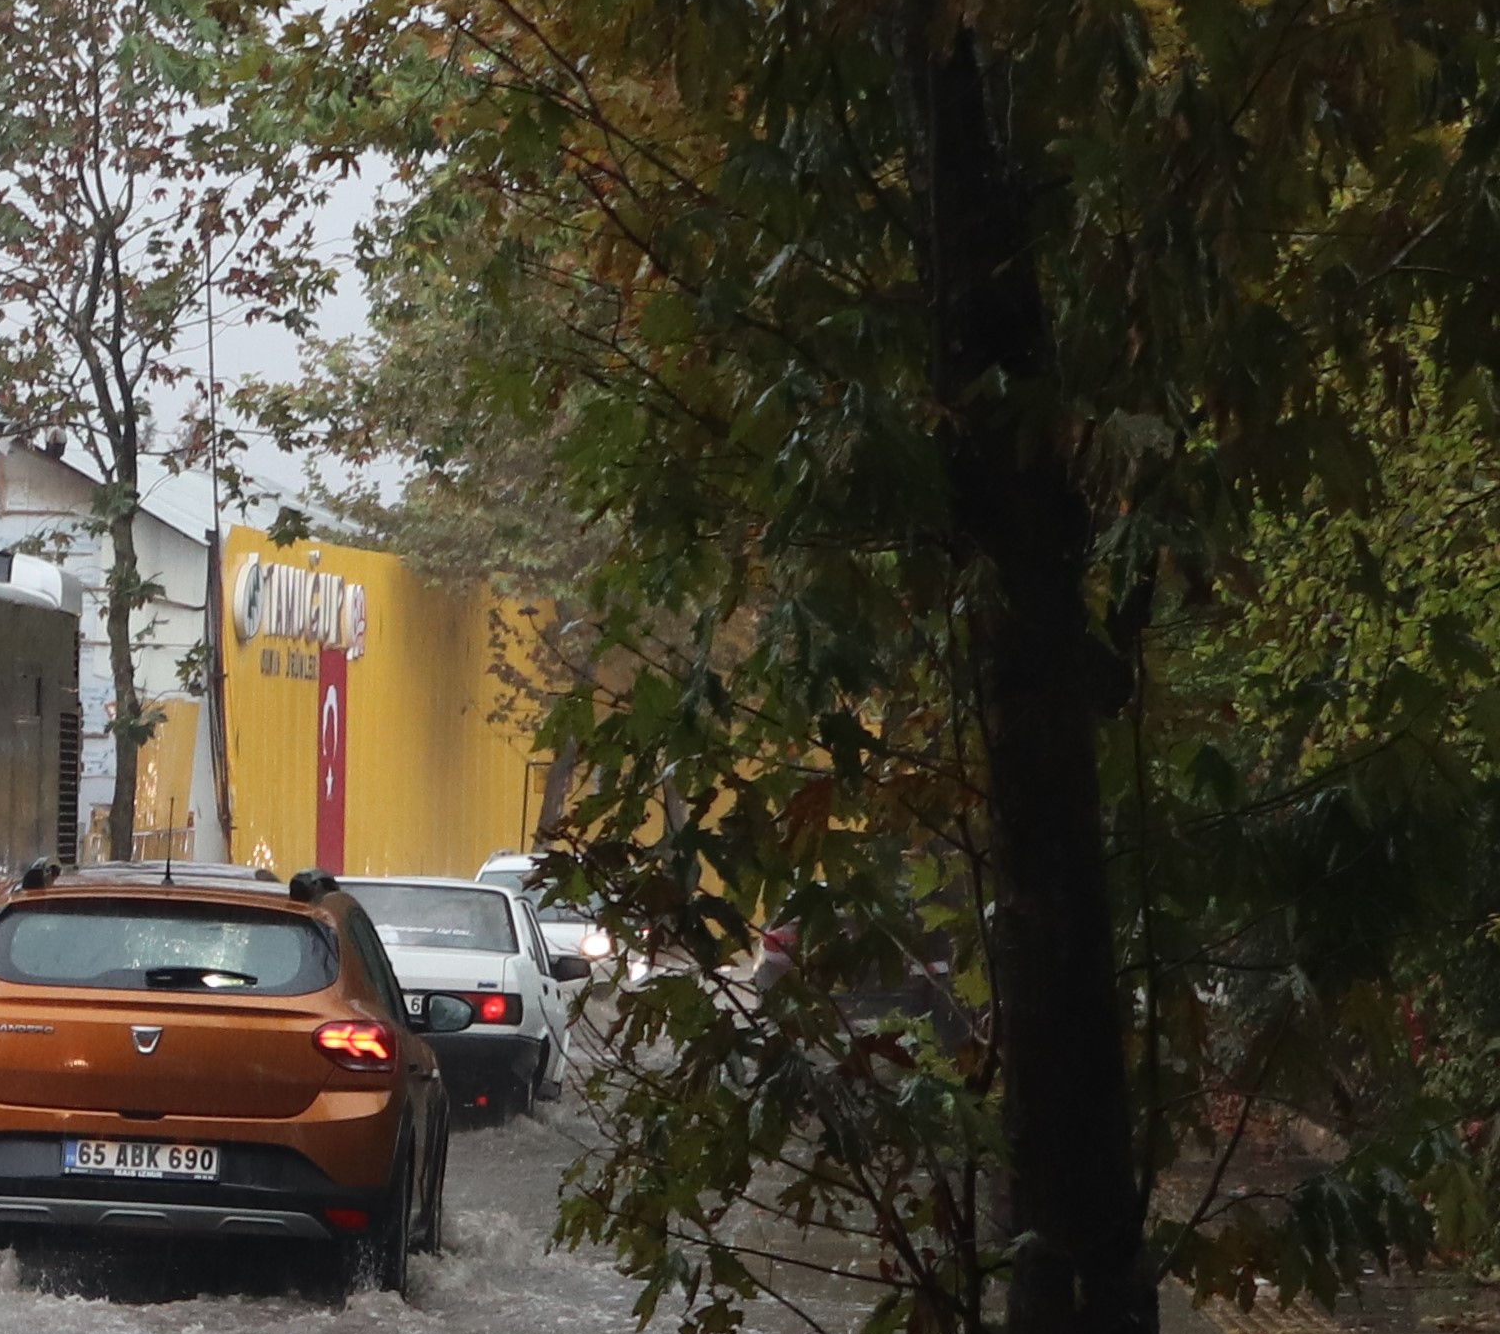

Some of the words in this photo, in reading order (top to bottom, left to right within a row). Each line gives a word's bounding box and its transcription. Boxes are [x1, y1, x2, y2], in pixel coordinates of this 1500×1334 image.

[78, 1141, 106, 1166] 65
[115, 1143, 161, 1169] ABK
[168, 1147, 213, 1171] 690
